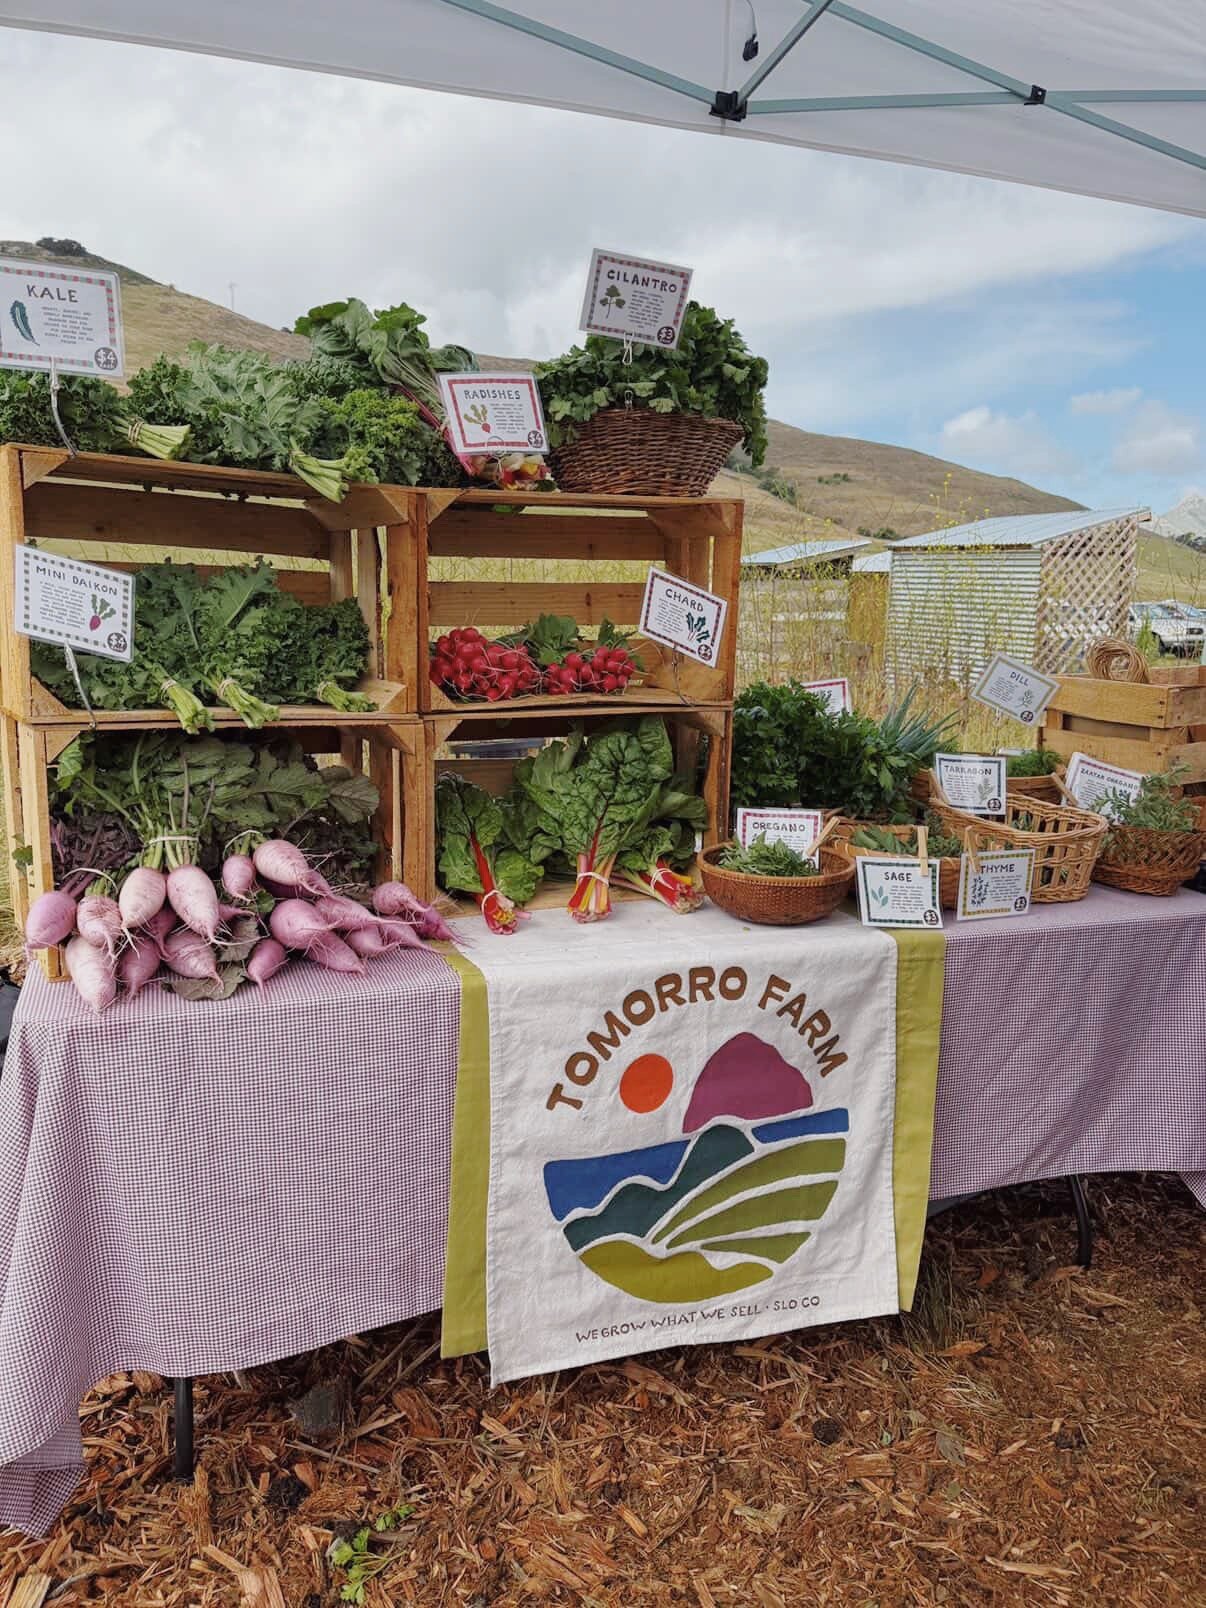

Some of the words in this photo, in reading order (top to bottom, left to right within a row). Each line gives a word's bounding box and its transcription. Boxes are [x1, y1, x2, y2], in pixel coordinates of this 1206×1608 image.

[606, 269, 678, 293] CILANTRO
[26, 284, 79, 303] KALE
[463, 388, 521, 400] RADISHES
[36, 565, 66, 581] MINI
[72, 575, 118, 596] DAIKON
[665, 588, 704, 612] CHARD
[1009, 671, 1029, 686] DILL
[943, 765, 992, 776] TARRAGON
[752, 821, 806, 833] OREGANO
[883, 871, 913, 882] SAGE
[980, 863, 1016, 875] THYME
[546, 965, 748, 1111] TOMORRO
[757, 973, 849, 1078] FARM
[575, 1328, 599, 1343] WE
[600, 1320, 646, 1338] GROW
[650, 1311, 698, 1329] WHAT
[700, 1308, 726, 1321] WE
[730, 1304, 762, 1318] SELL
[773, 1299, 798, 1311] SLO
[801, 1295, 821, 1308] CO
